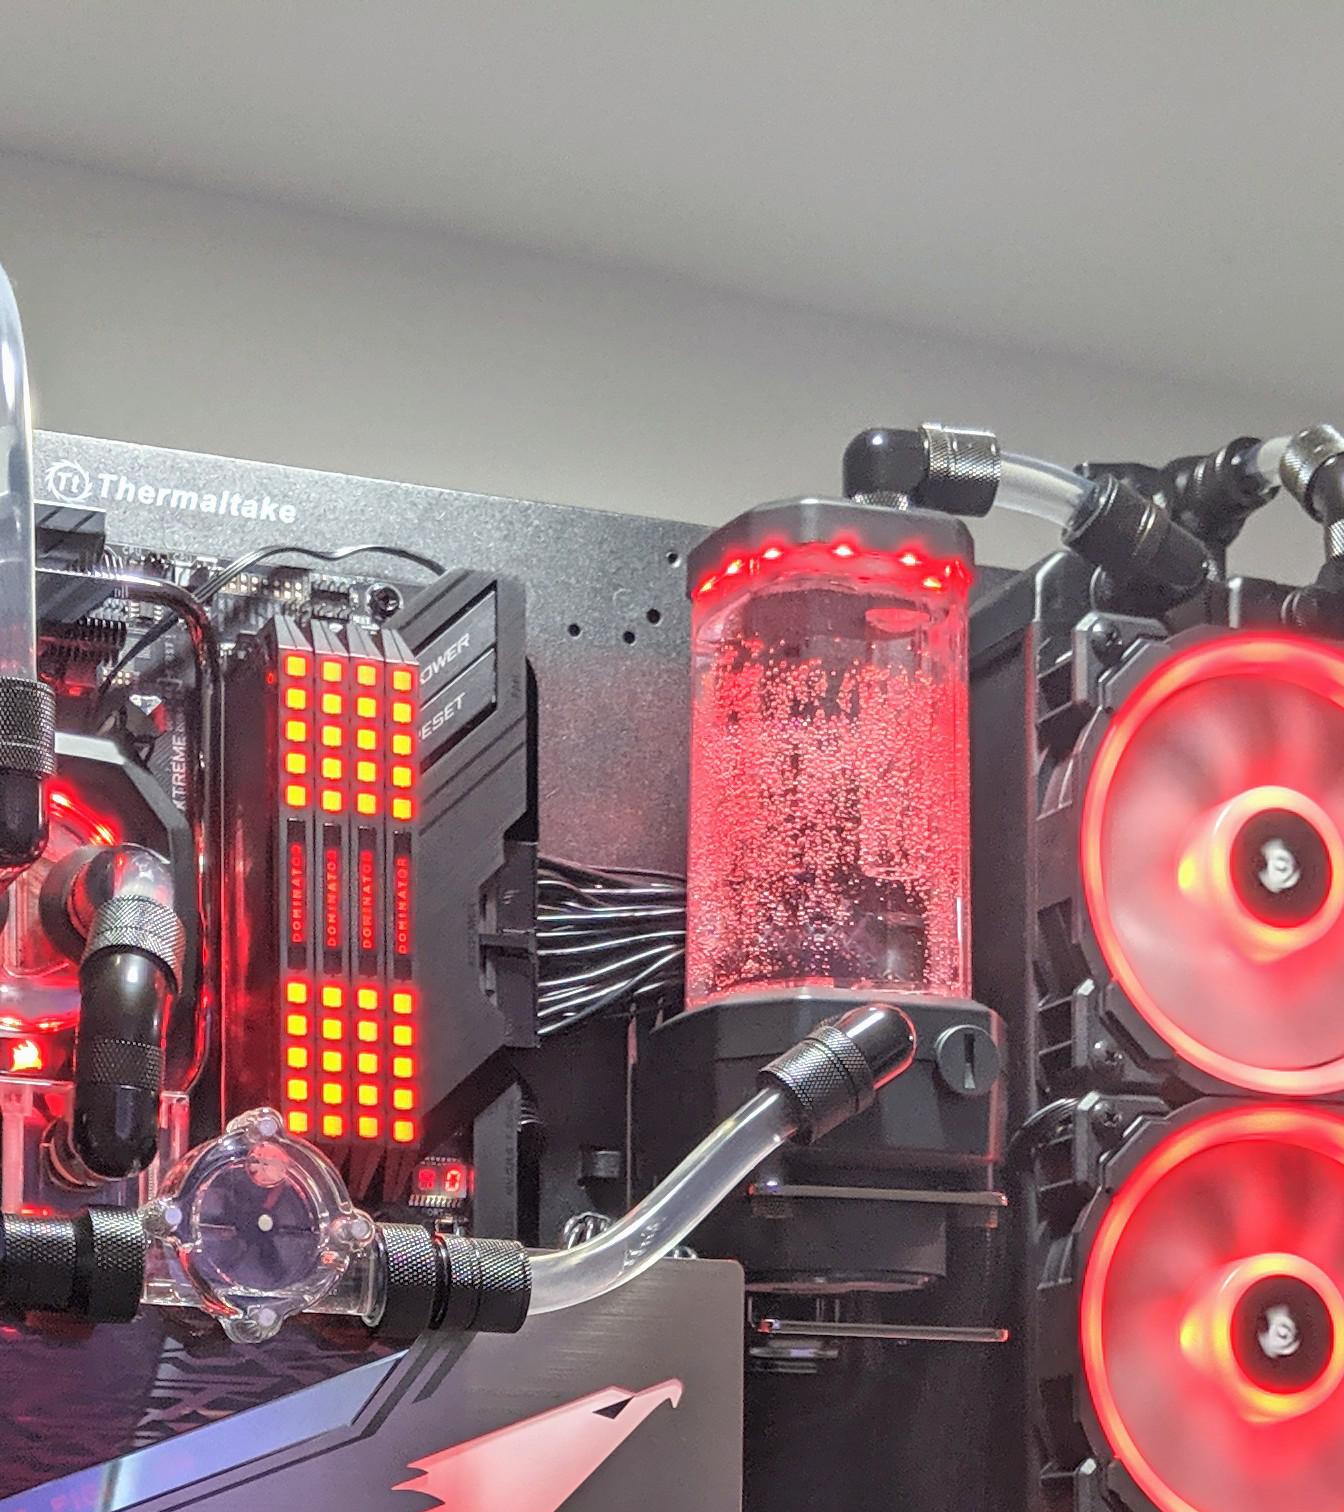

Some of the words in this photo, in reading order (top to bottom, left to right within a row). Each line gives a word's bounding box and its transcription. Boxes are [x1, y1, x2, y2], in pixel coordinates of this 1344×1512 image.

[96, 472, 298, 526] Thermaltake
[419, 633, 470, 685] OWER
[419, 692, 466, 742] ESET
[291, 843, 304, 944] DOMINATOR
[326, 849, 338, 947] DOMINATOR
[361, 850, 373, 950] DOMINATOR
[396, 856, 408, 955] DOMINATOR
